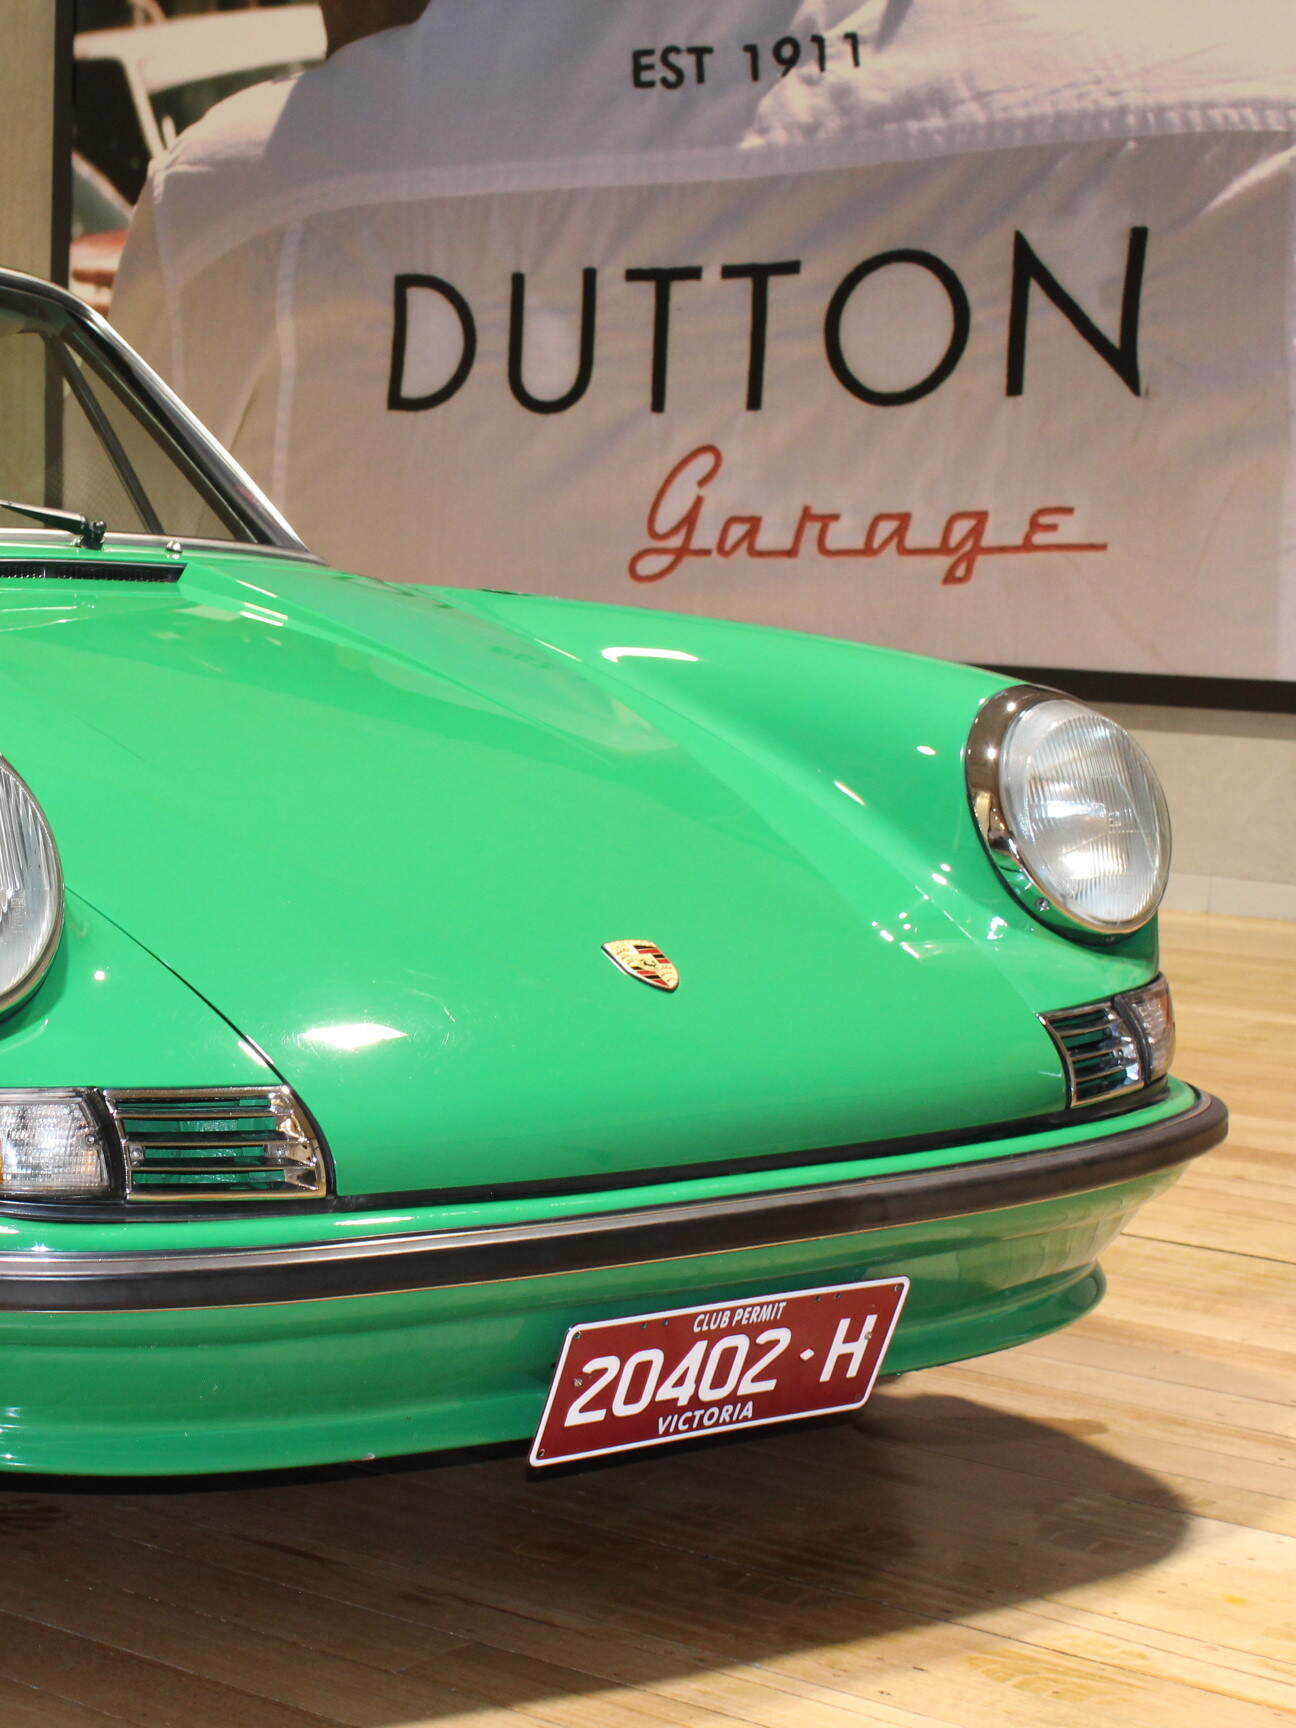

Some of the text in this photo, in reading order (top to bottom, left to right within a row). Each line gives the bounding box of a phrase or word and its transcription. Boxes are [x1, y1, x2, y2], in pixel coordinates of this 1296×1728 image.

[631, 31, 863, 91] EST 1911
[387, 226, 1149, 415] DUTTON
[627, 443, 1108, 585] Garage
[693, 1301, 787, 1333] CLUB PERMIT
[657, 1400, 754, 1436] VICTORIA
